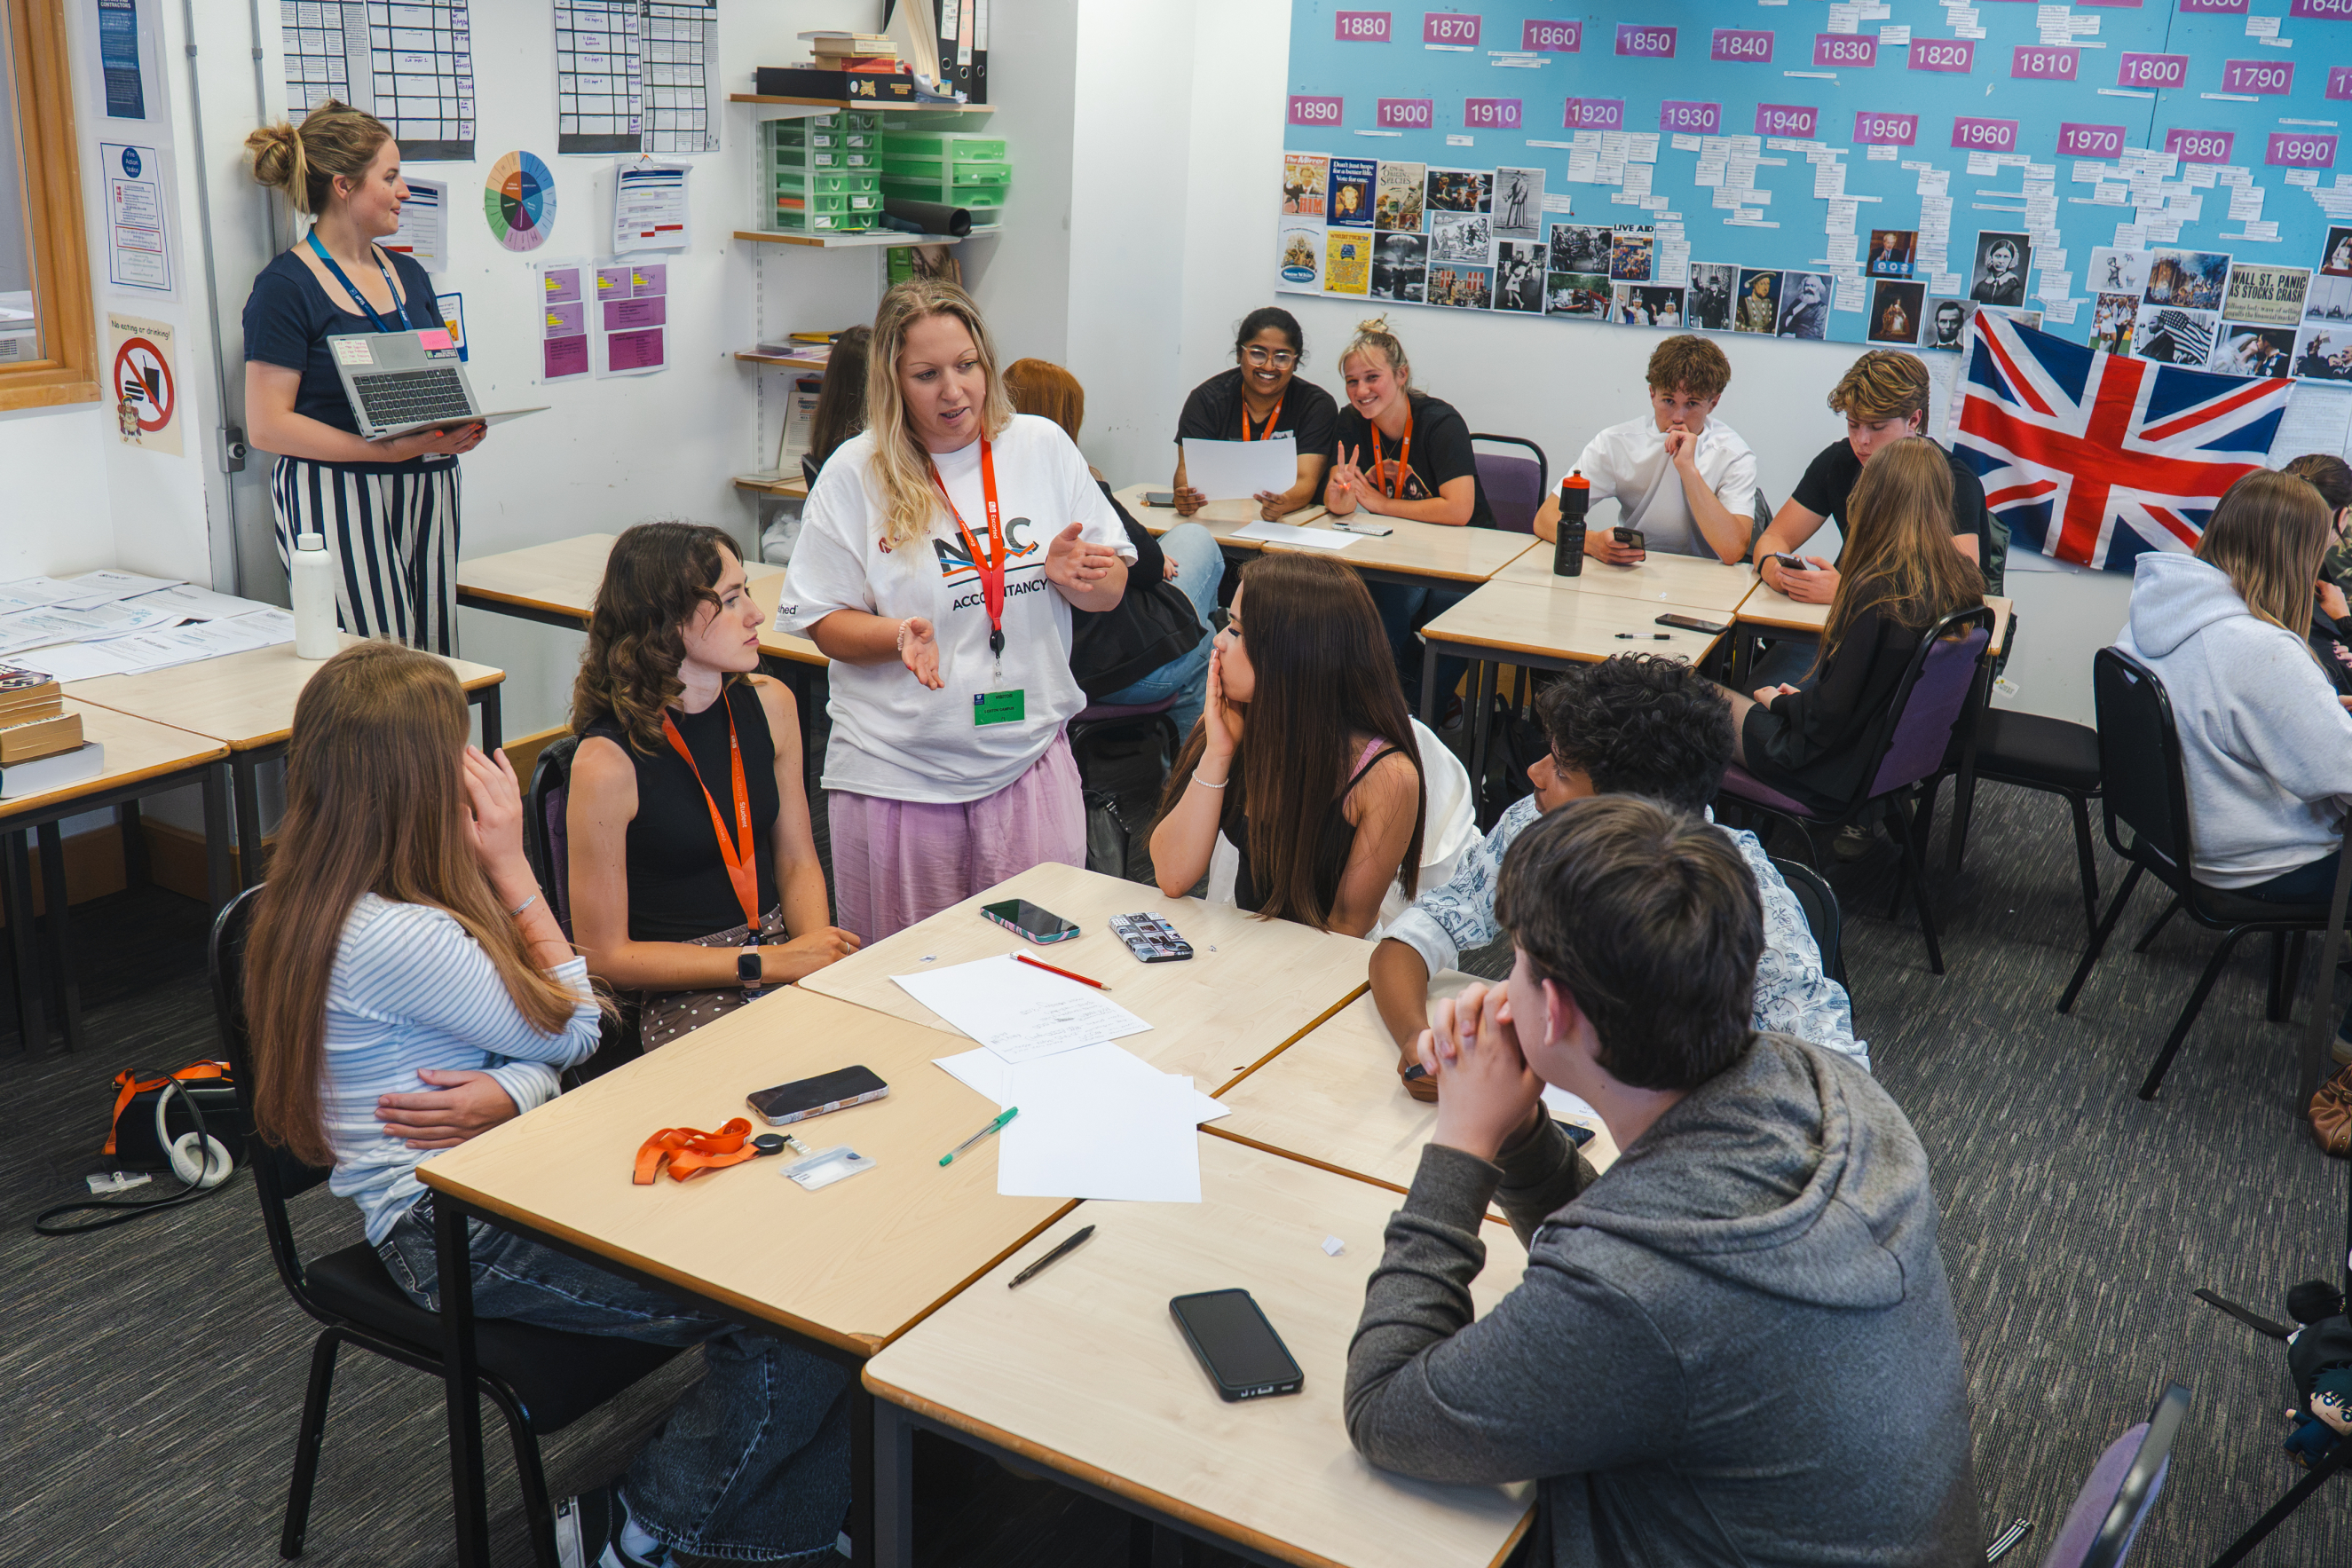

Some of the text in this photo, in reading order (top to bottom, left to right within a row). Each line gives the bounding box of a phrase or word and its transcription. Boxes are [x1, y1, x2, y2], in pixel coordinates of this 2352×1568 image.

[1341, 17, 1385, 35] 1880
[1430, 20, 1475, 39] 1870
[1529, 27, 1575, 45] 1860
[1623, 32, 1669, 51] 1850
[1719, 36, 1768, 56] 1840
[1821, 41, 1870, 60] 1830
[1916, 46, 1967, 67] 1820
[2020, 53, 2072, 74] 1810
[2127, 60, 2180, 81] 1800
[2232, 67, 2285, 88] 1790
[1294, 102, 1338, 120] 1890
[1383, 105, 1428, 122] 1900
[1471, 105, 1516, 122] 1910
[1572, 105, 1618, 124] 1920
[1668, 108, 1716, 127] 1930
[1764, 111, 1811, 131] 1940
[1861, 119, 1911, 139] 1950
[1961, 124, 2010, 145] 1960
[2066, 130, 2117, 151] 1970
[2174, 138, 2225, 158] 1980
[2276, 141, 2328, 161] 1990
[1298, 156, 1325, 164] Mirror
[1333, 161, 1348, 169] Don't
[1381, 176, 1411, 186] SPECIES
[1384, 169, 1406, 178] ORIGIN
[1299, 197, 1323, 213] HIM
[2232, 271, 2306, 290] WALL ST. PANIC
[2228, 284, 2304, 303] AS STOCKS CRASH
[111, 320, 120, 329] No
[121, 324, 138, 334] eating
[146, 327, 170, 340] drinking!
[953, 578, 1047, 611] ACCOTANCY
